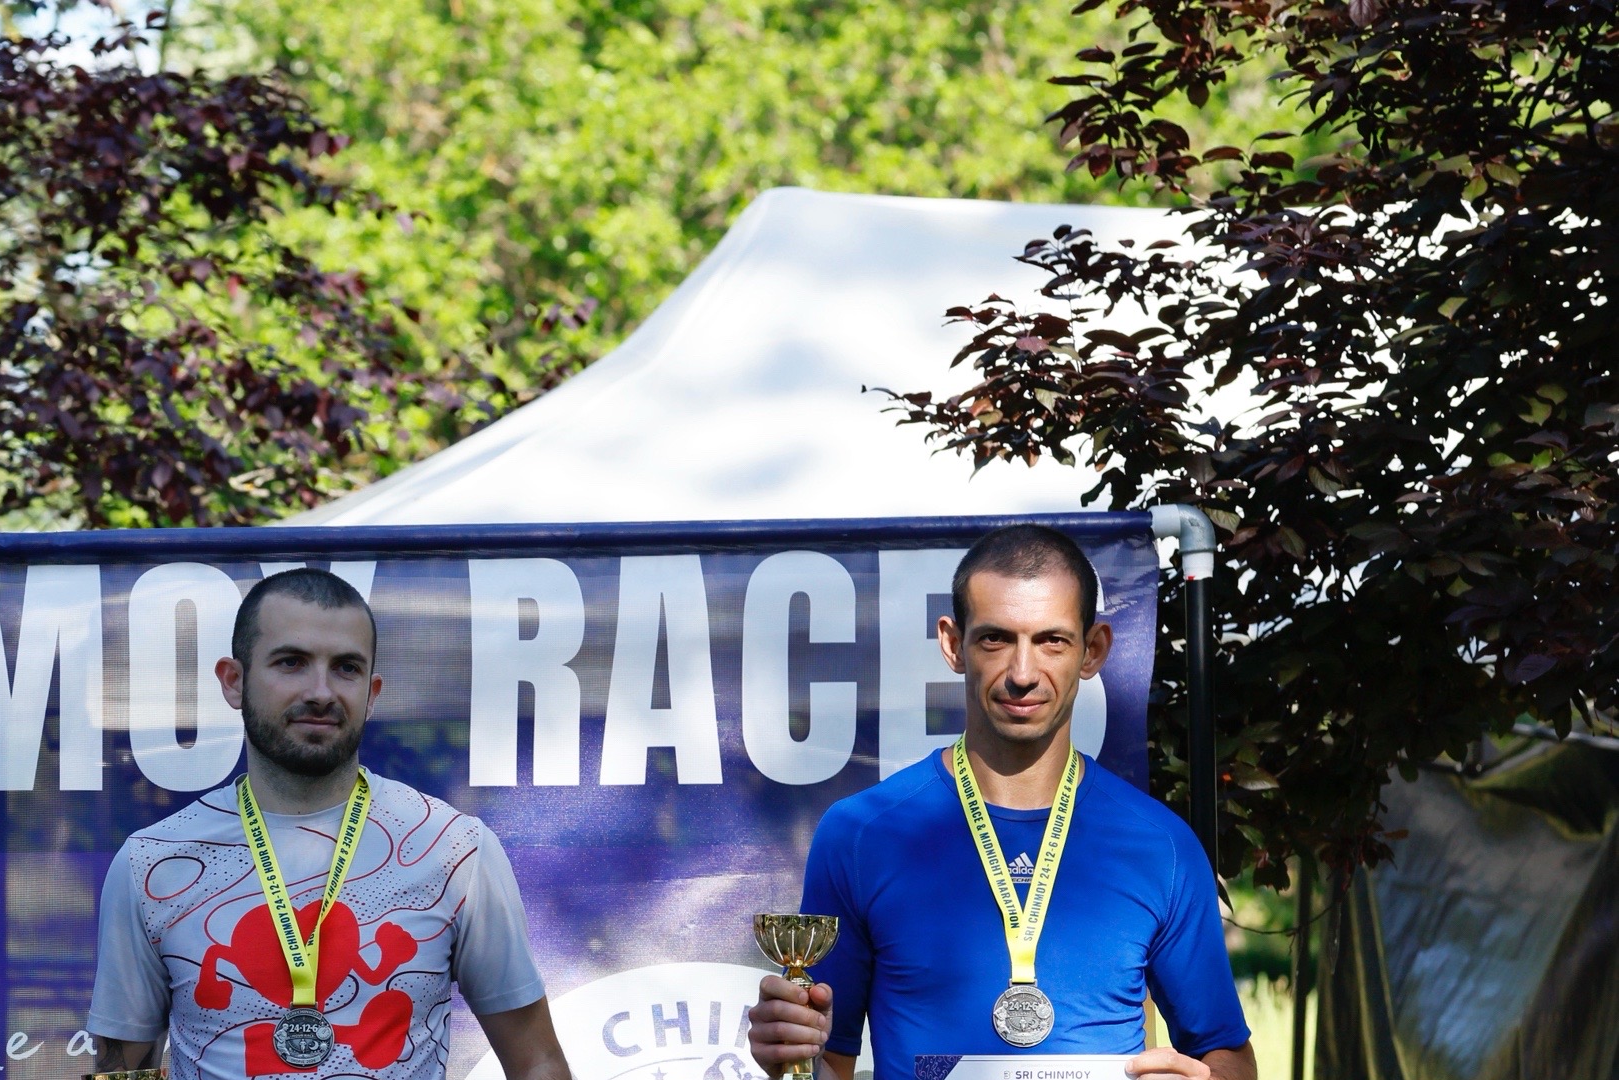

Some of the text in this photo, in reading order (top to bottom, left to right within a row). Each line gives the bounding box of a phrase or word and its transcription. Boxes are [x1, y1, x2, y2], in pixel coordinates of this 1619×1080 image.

[468, 550, 1108, 786] RACE
[960, 773, 976, 801] HOUR
[968, 800, 984, 824] RACE
[976, 824, 986, 832] &
[325, 801, 365, 899] HOUR RACE & MIDNIGHT
[979, 832, 1003, 876] MIDNIGHT
[1023, 785, 1072, 942] SRI CHINMOY 24-12-6 HOUR RACE &
[249, 817, 305, 968] SRI CHINMOY 24-12-6 HOUR RACE &
[996, 878, 1020, 929] MARATHON
[1015, 1070, 1091, 1079] SRI CHINMOY
